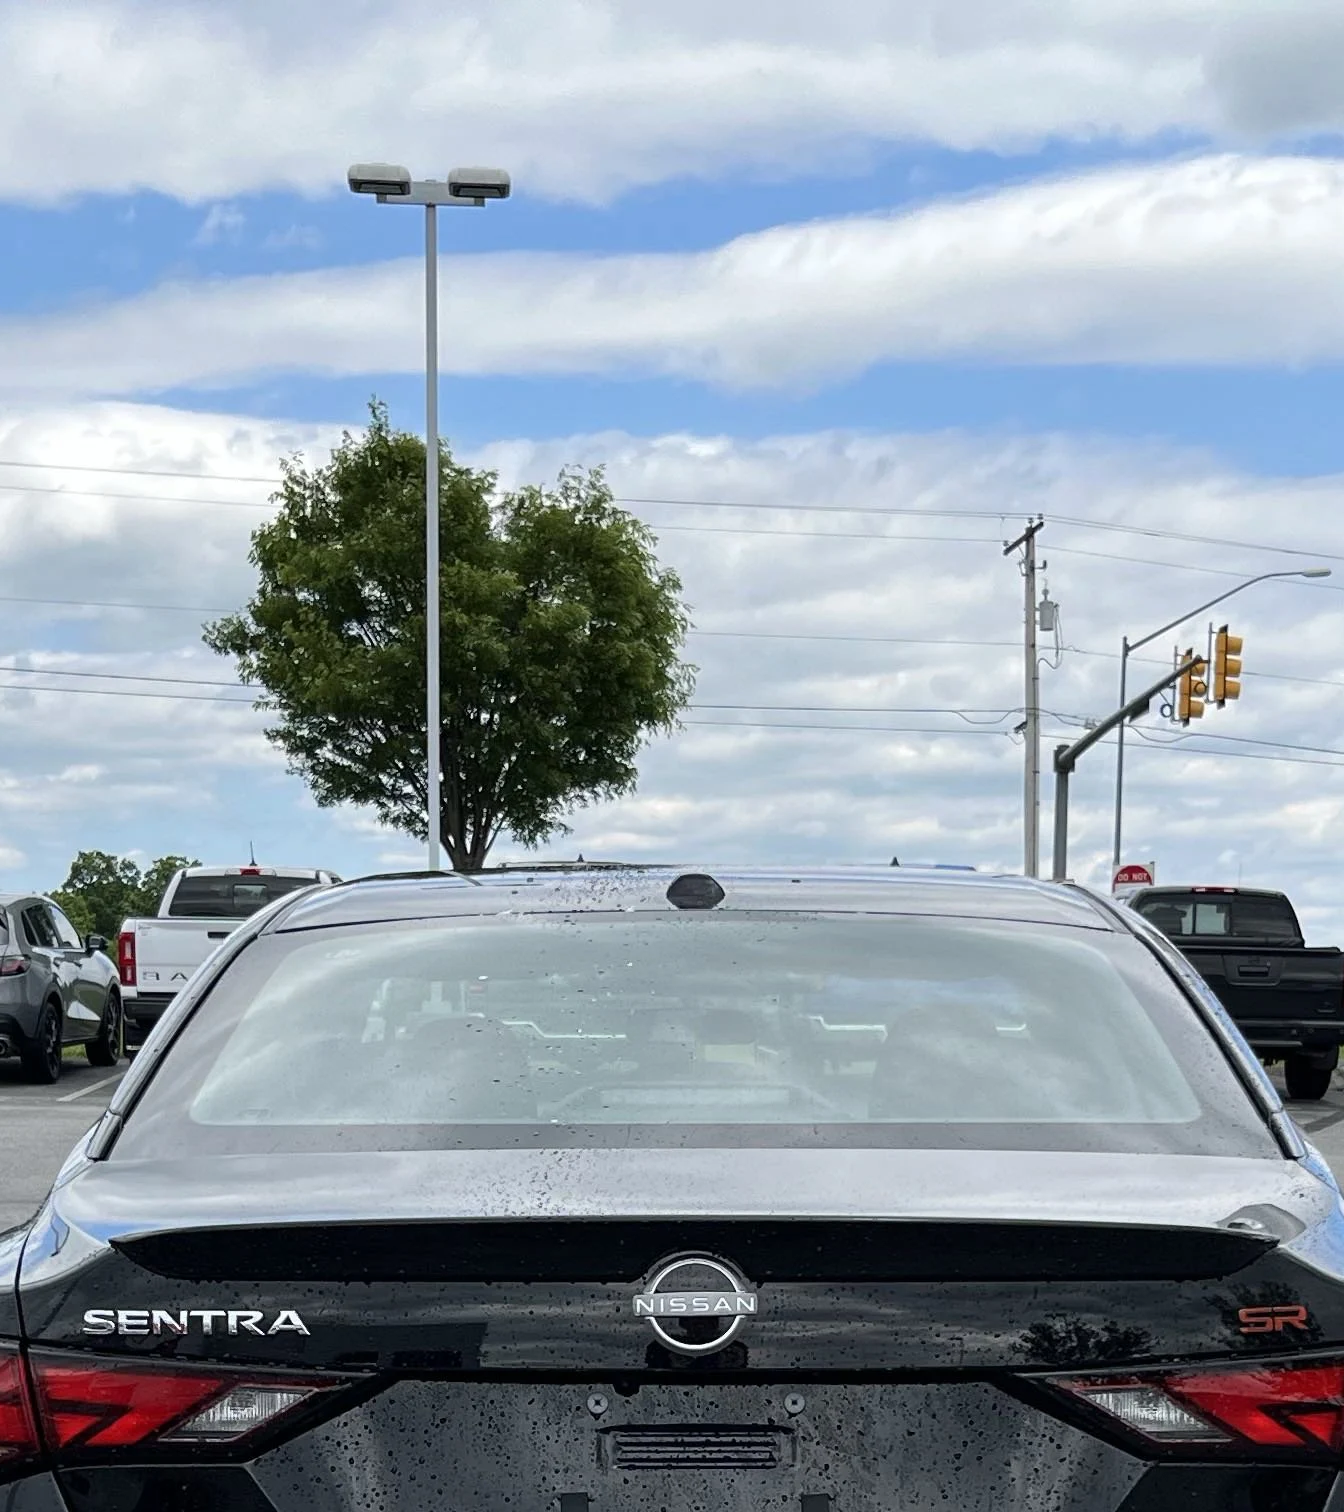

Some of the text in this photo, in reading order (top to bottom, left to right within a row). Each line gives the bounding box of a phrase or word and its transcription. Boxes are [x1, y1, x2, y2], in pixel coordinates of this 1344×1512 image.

[1117, 872, 1148, 881] DO NOT
[636, 1297, 755, 1313] NISSAN
[82, 1309, 311, 1336] SENTRA
[1238, 1304, 1310, 1334] SR
